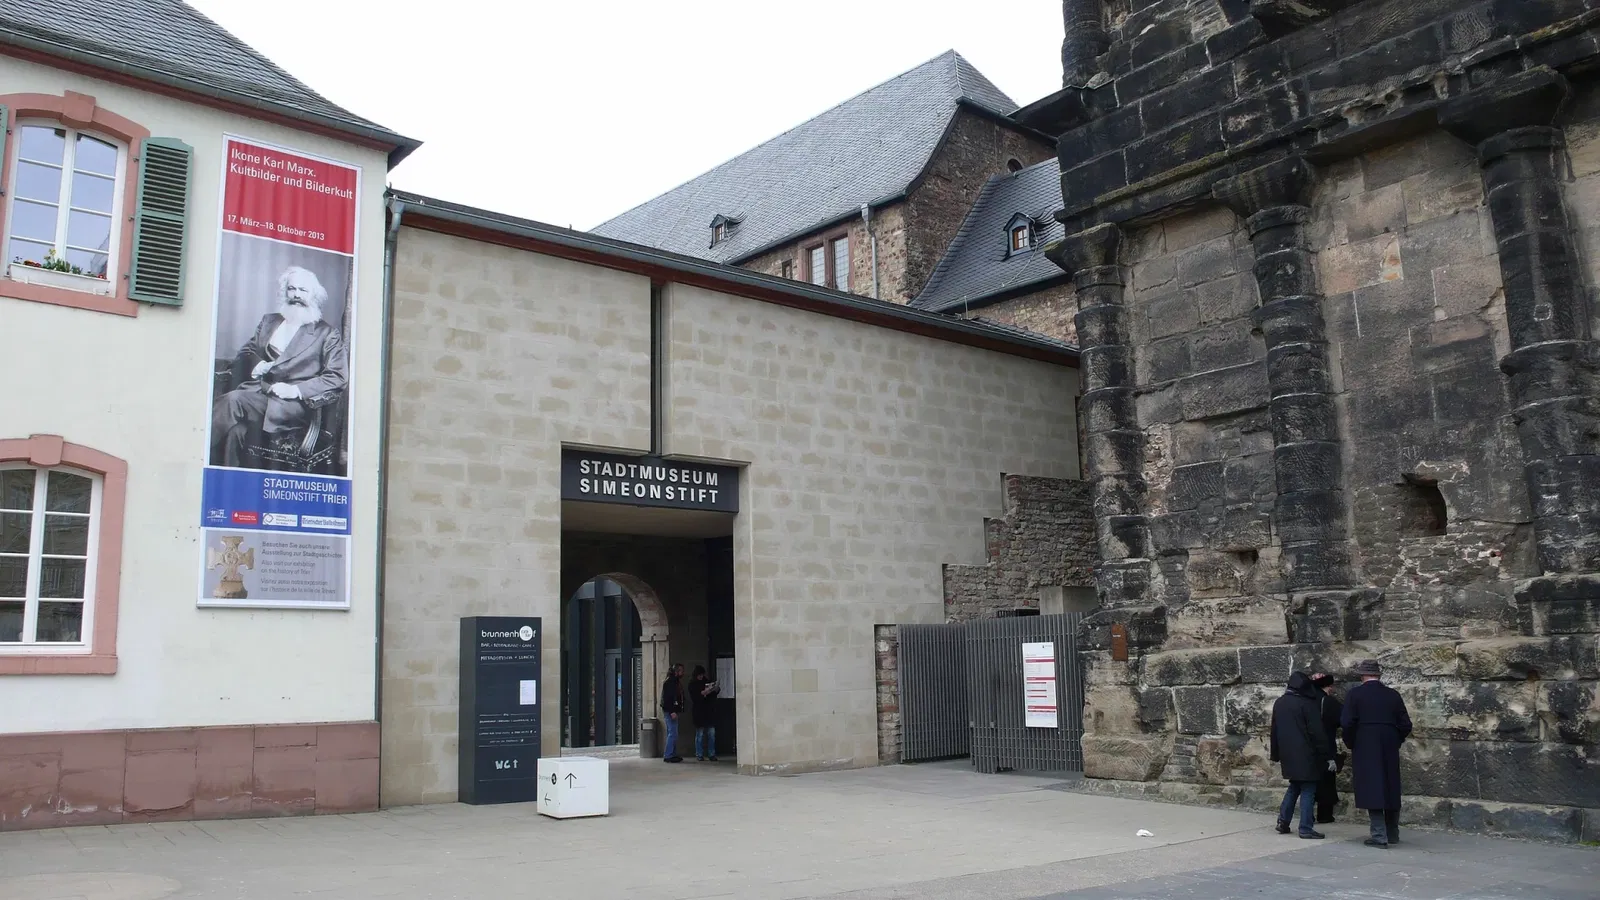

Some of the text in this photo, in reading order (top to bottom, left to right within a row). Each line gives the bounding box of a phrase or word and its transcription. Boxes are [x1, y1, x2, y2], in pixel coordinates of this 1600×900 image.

[231, 148, 317, 177] Ikone Karl Marx.
[230, 163, 353, 200] Kultbilder und Bilderkult
[227, 214, 238, 224] 17.
[277, 224, 306, 237] Oktober
[308, 230, 325, 241] 2013
[263, 478, 337, 493] STADTMUSEUM
[580, 459, 718, 486] STADTMUSEUM
[263, 489, 348, 505] SIMEONSTIFT TRIER
[580, 478, 718, 503] SIMEONSTIFT
[495, 759, 511, 770] WC
